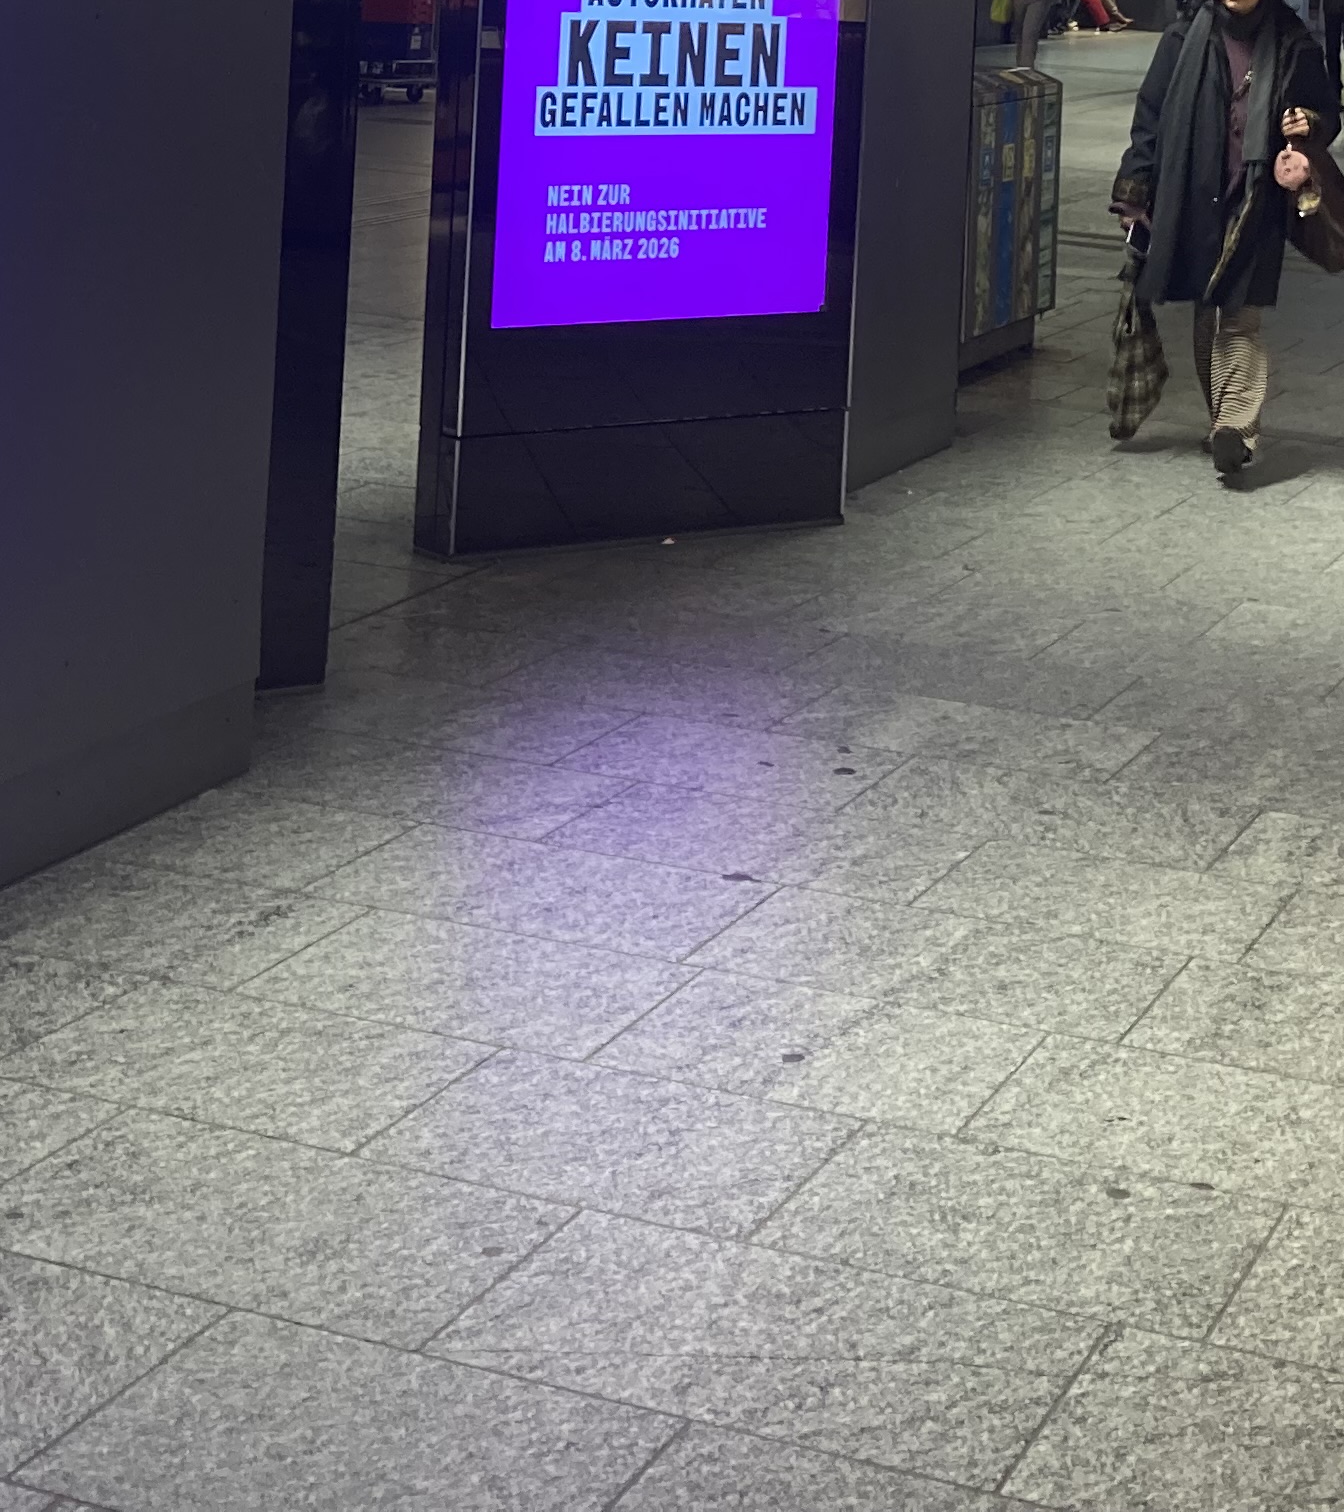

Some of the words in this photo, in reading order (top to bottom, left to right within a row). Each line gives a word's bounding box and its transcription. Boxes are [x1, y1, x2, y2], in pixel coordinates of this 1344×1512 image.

[567, 18, 781, 88] KEINEN
[540, 91, 690, 128] GEFALLEN
[699, 92, 806, 127] MACHEN
[547, 185, 593, 207] NEIN
[597, 184, 631, 206] ZUR
[546, 208, 767, 235] HALBIERUNGSINITIATIVE
[544, 240, 566, 263] AM
[571, 240, 587, 261] 8.
[590, 236, 633, 261] MÄRZ
[637, 237, 680, 259] 2026
